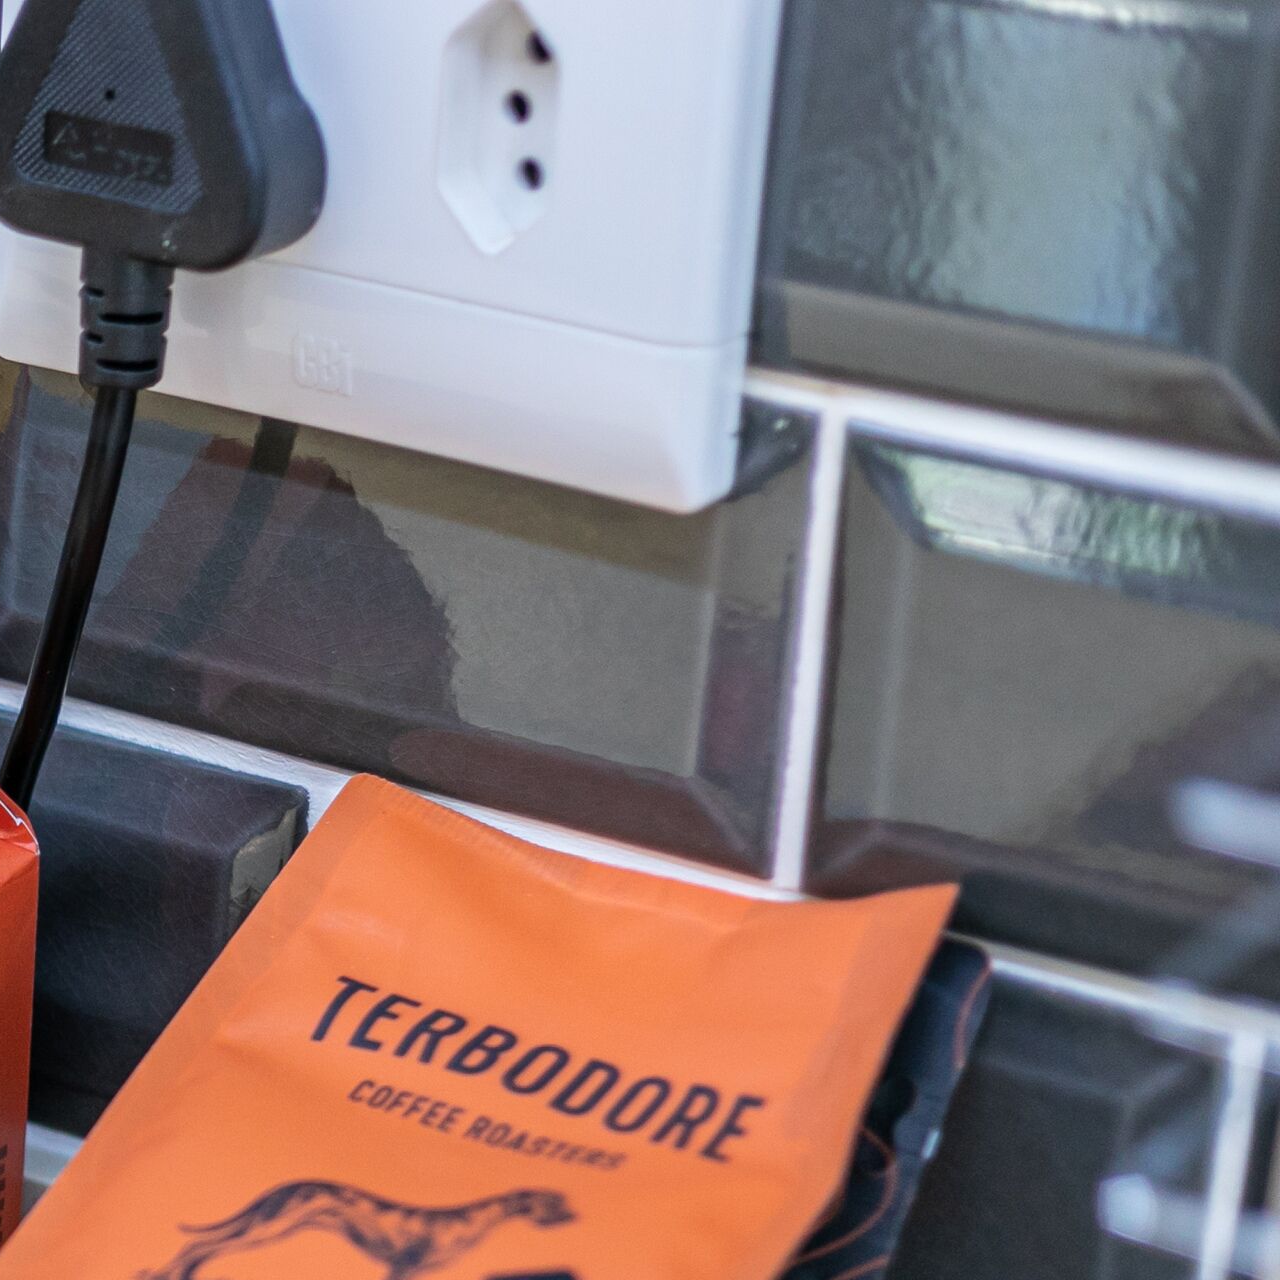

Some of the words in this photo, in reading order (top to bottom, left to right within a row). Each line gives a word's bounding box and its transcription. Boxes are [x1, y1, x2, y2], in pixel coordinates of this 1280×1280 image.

[310, 975, 765, 1163] TERBODORE
[347, 1079, 465, 1133] COFFEE
[463, 1115, 627, 1170] ROASTERS
